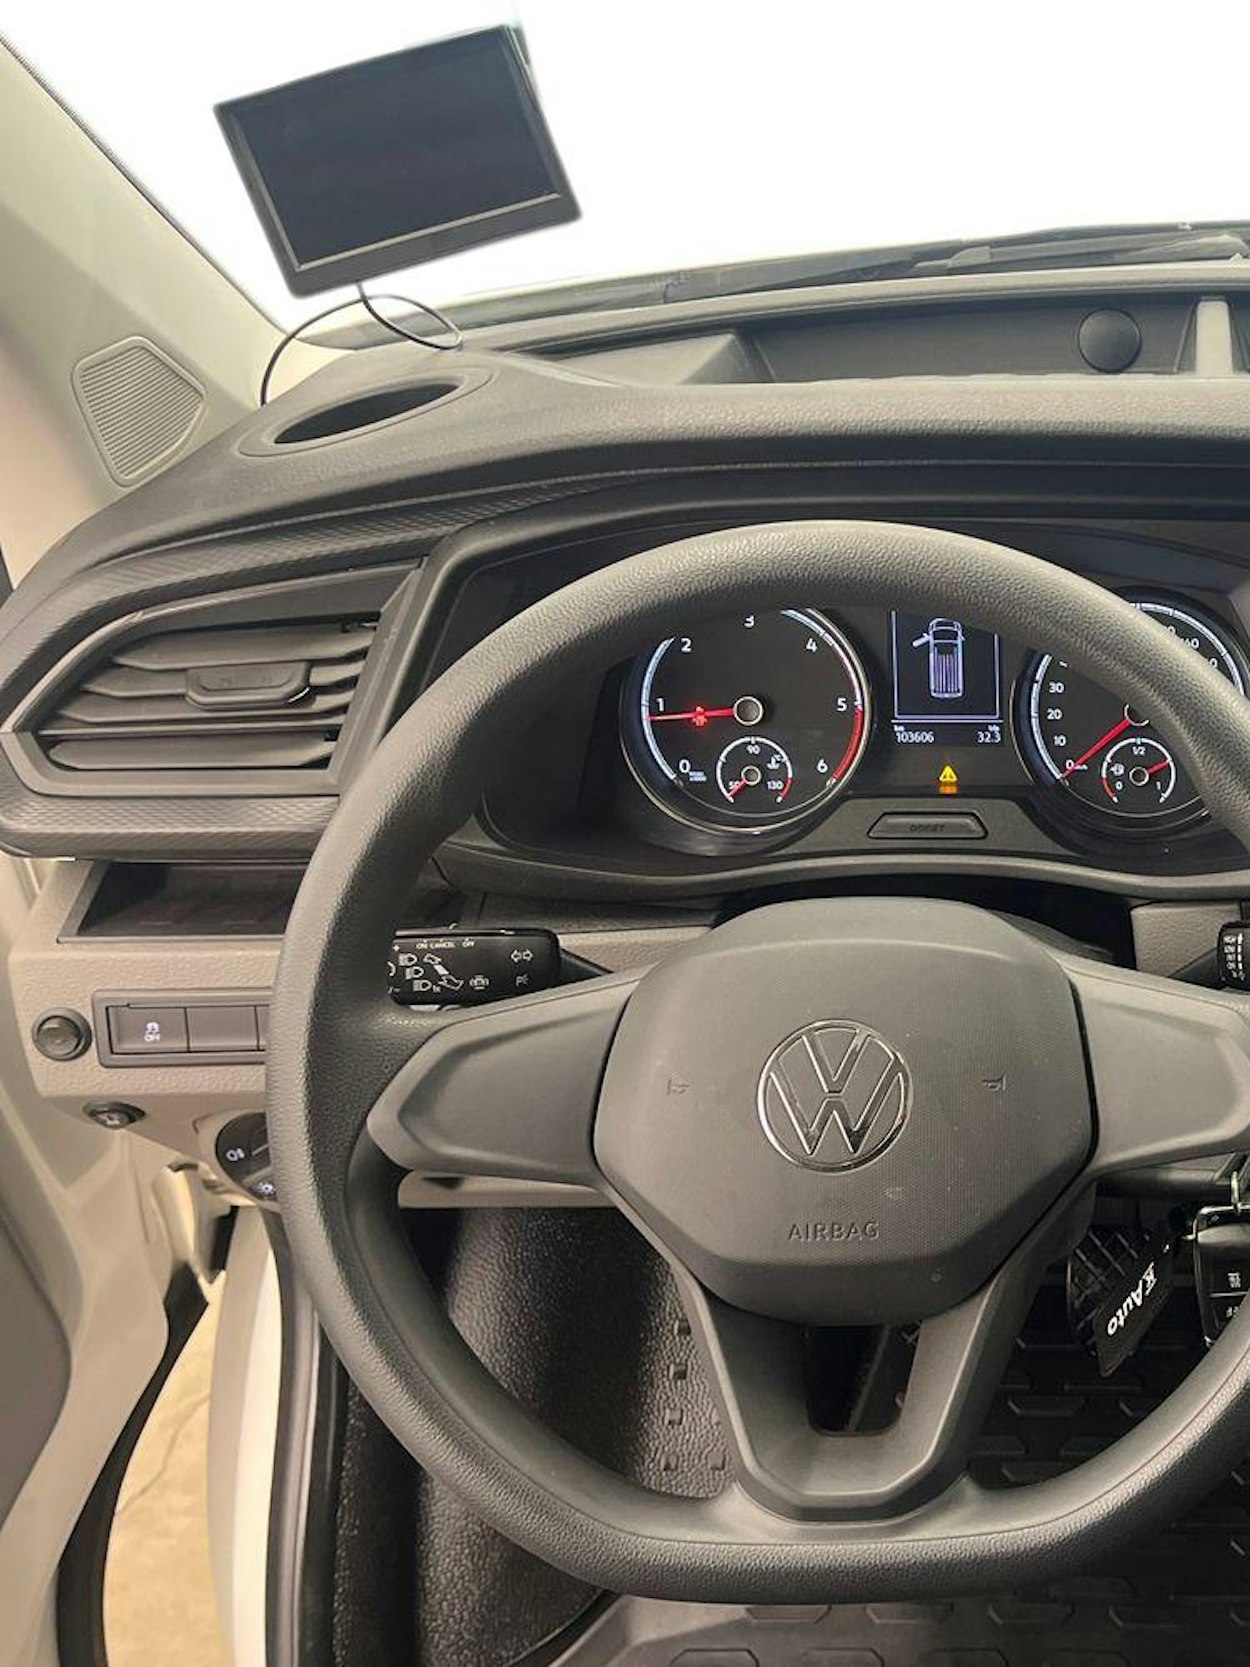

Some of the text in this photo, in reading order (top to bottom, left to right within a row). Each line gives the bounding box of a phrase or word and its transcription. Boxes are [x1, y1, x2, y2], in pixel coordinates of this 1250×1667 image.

[744, 614, 755, 629] 3
[680, 637, 692, 653] 2
[805, 637, 818, 653] 4
[1048, 682, 1065, 694] 30
[655, 697, 665, 712] 1
[836, 697, 848, 712] 5
[1046, 708, 1063, 721] 20
[895, 731, 935, 743] 103606
[1053, 735, 1067, 748] 10
[678, 759, 691, 774] 0
[816, 759, 829, 774] 6
[765, 780, 784, 790] 130
[787, 1221, 880, 1241] AIRBAG
